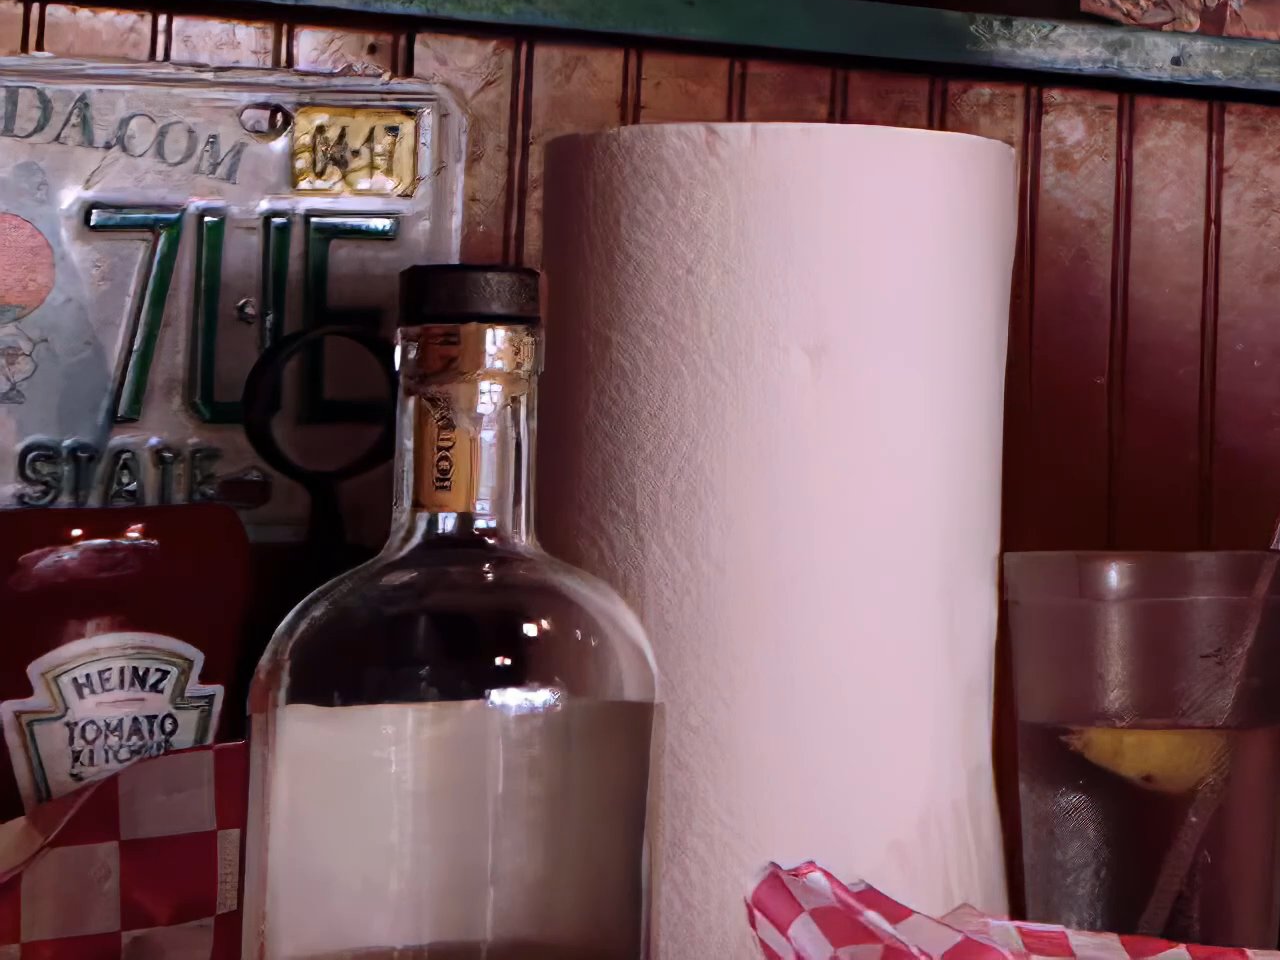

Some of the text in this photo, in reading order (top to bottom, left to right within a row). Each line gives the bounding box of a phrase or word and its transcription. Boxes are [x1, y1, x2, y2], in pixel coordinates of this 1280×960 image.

[17, 440, 224, 506] STATE
[72, 665, 171, 700] HEINZ
[64, 712, 179, 747] TOMATO
